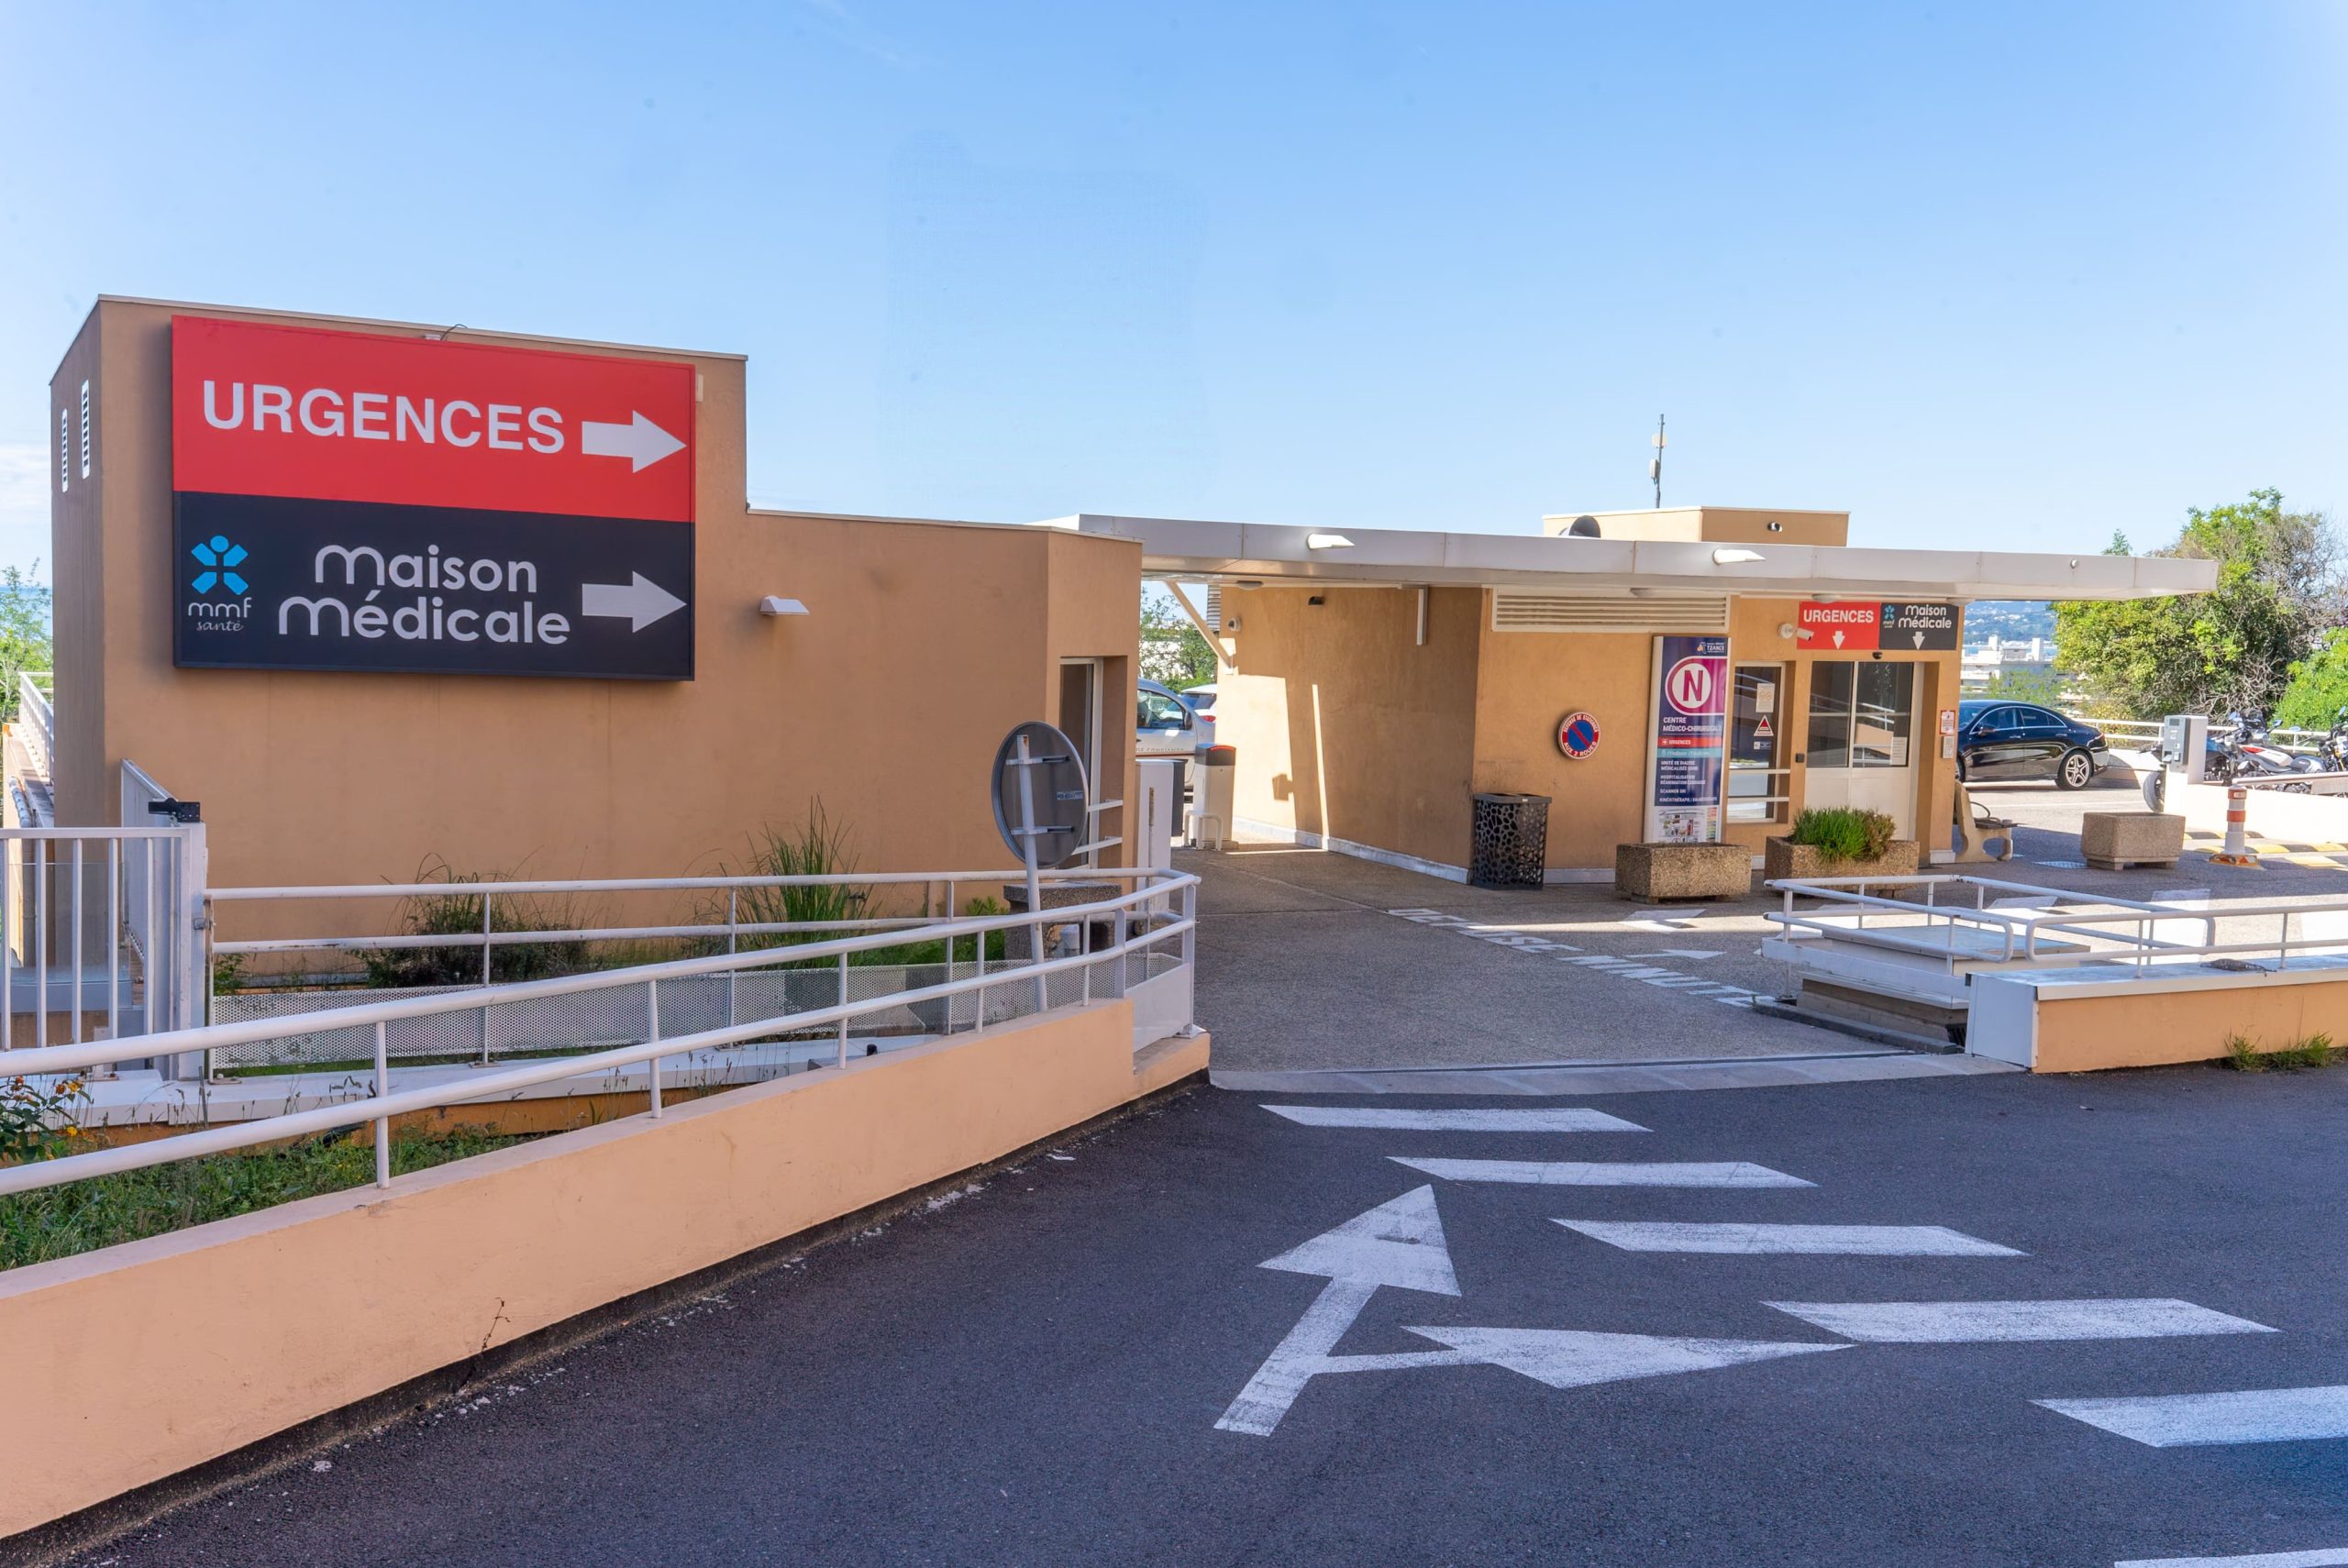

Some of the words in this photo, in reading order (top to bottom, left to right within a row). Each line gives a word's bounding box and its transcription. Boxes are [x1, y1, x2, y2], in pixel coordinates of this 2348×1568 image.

[203, 380, 566, 454] URGENCES
[315, 544, 538, 593] maison
[188, 597, 252, 618] mmf
[278, 590, 571, 645] médicale
[1803, 609, 1875, 624] URGENCES
[1905, 604, 1947, 616] maison
[196, 621, 245, 632] santé
[1898, 616, 1953, 629] médicale
[1682, 669, 1703, 701] N
